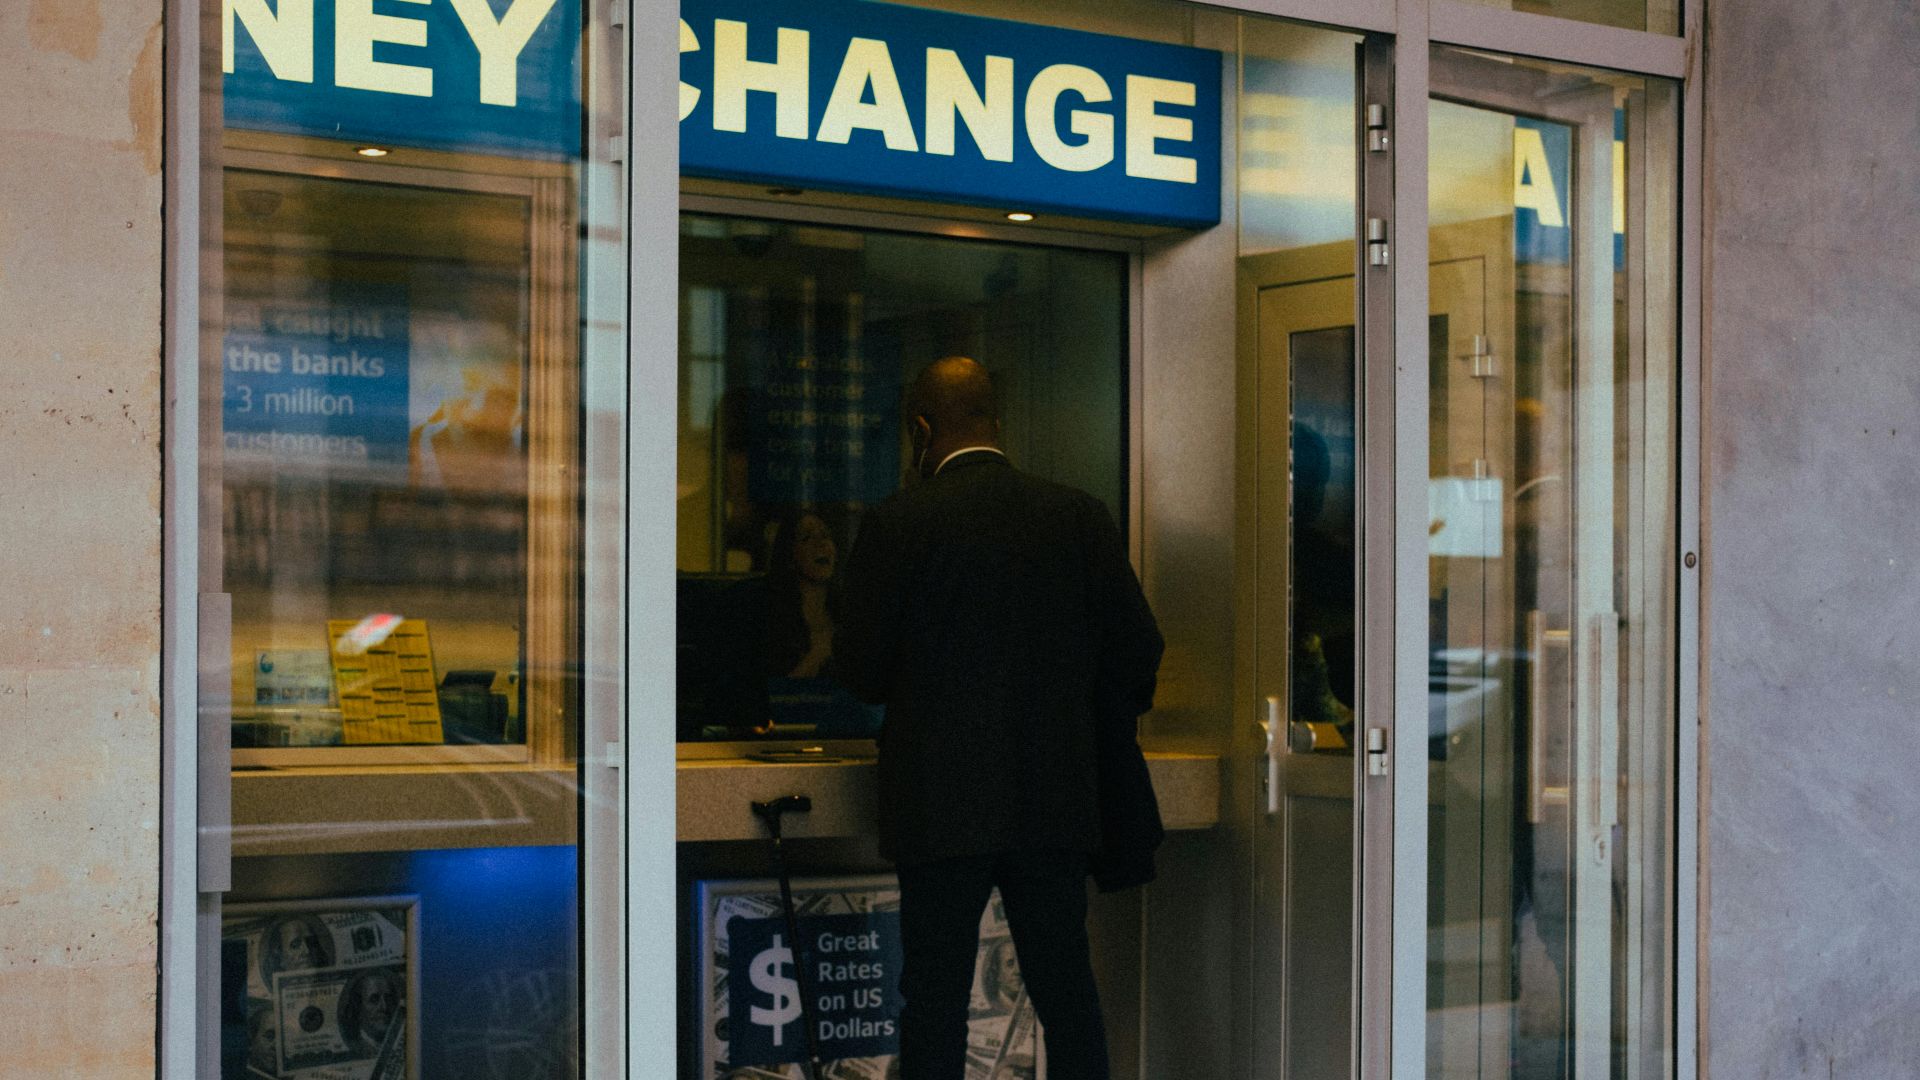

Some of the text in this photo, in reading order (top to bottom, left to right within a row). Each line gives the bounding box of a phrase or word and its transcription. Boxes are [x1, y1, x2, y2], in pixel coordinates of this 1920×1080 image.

[222, 0, 556, 107] NEY
[680, 17, 1198, 184] HANGE
[227, 344, 386, 378] the banks
[236, 385, 355, 416] 3 million
[224, 429, 368, 456] customers
[817, 929, 881, 954] Great
[817, 961, 885, 983] Rates
[817, 987, 884, 1011] on US
[817, 1018, 895, 1042] Dollars
